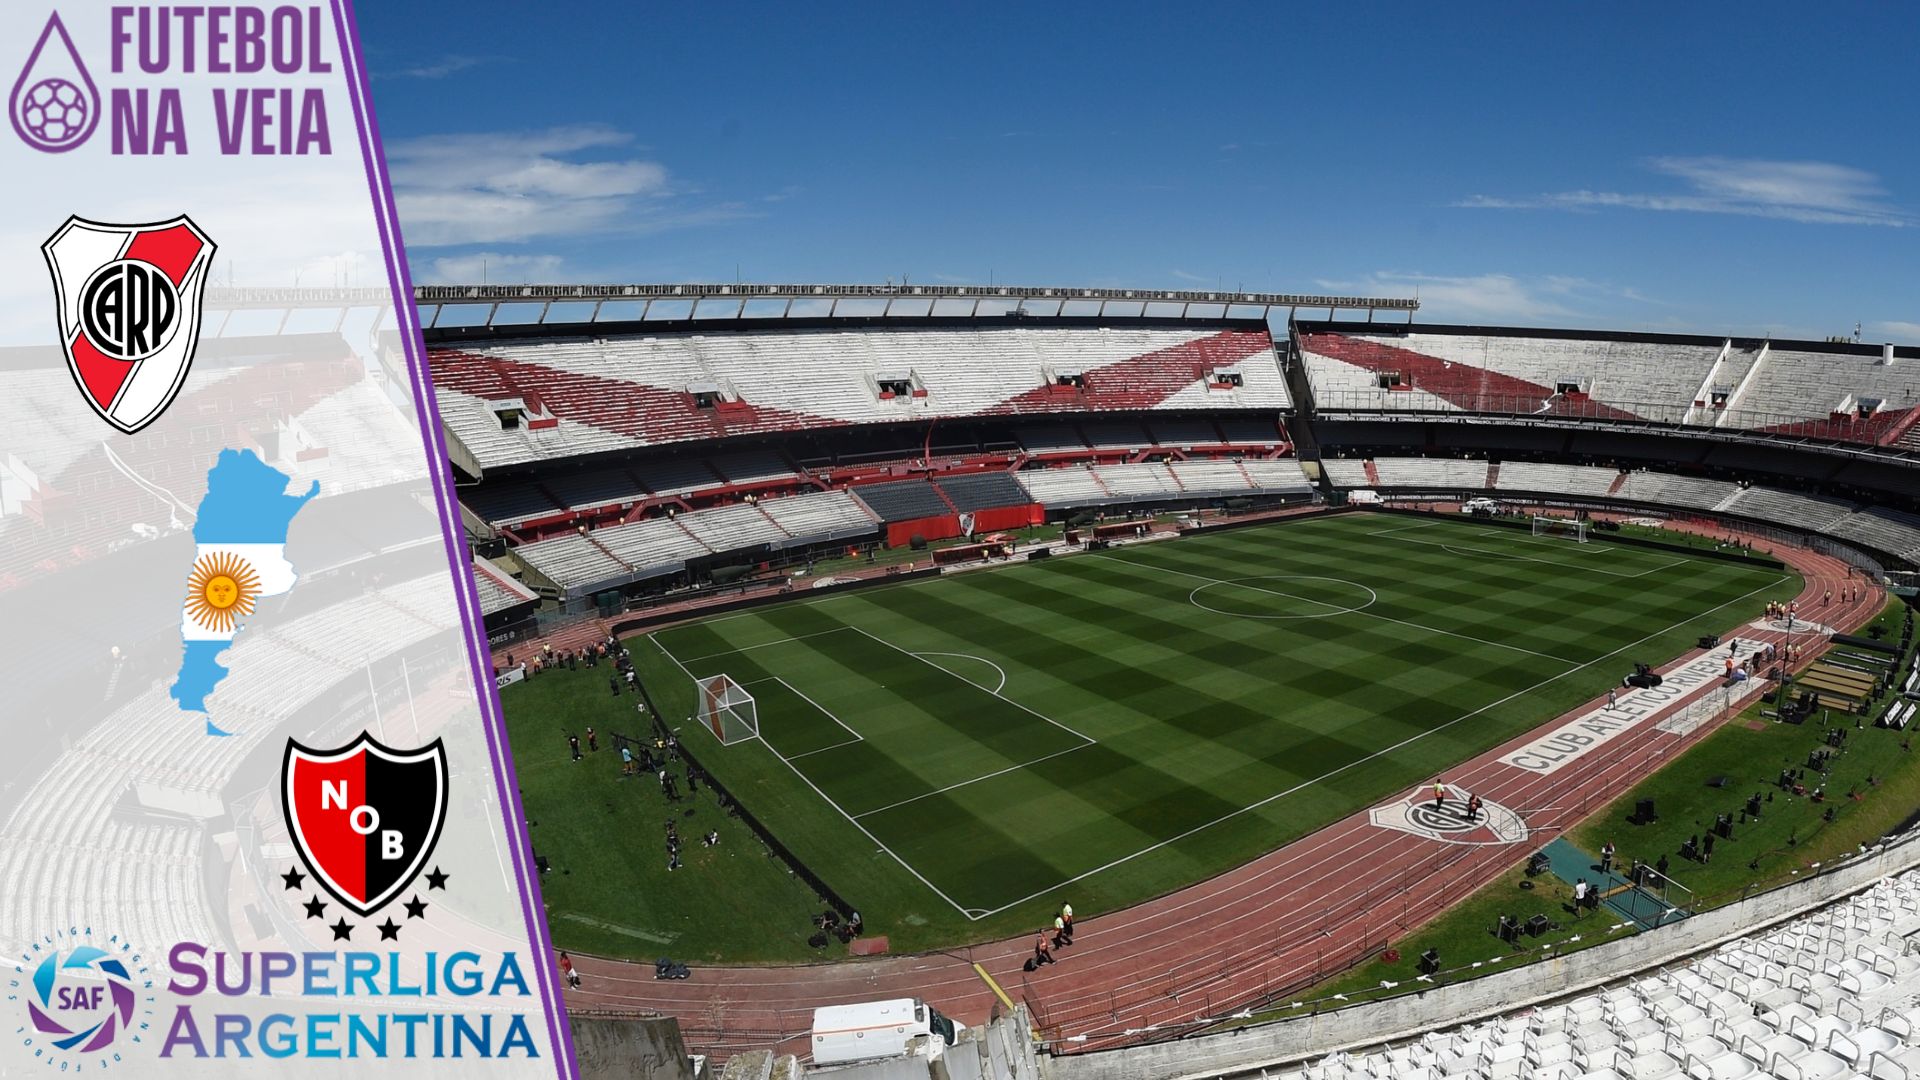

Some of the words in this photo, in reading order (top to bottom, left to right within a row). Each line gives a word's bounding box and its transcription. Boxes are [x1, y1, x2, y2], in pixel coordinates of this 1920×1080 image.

[1512, 733, 1594, 769] CLUB
[1579, 682, 1682, 736] ATLETICO
[1662, 660, 1724, 687] RIVER
